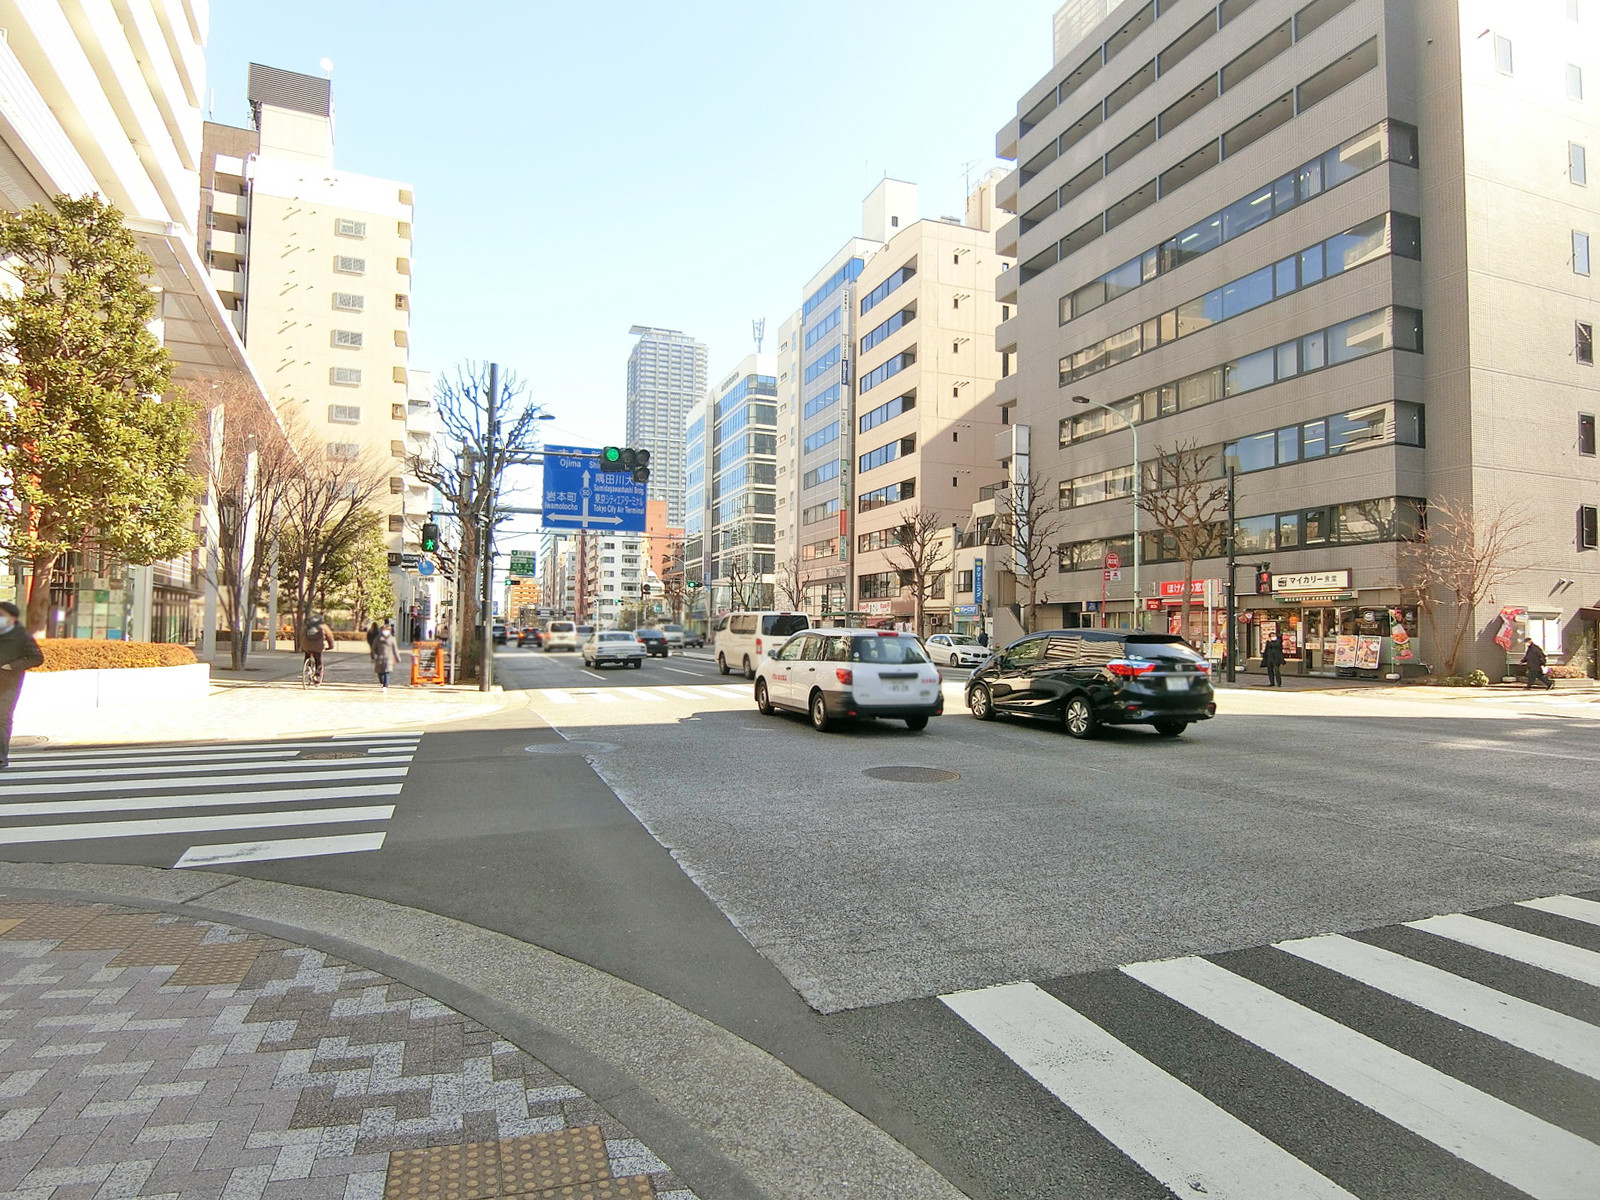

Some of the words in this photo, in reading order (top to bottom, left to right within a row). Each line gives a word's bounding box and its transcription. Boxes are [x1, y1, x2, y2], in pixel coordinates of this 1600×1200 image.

[560, 458, 581, 468] Ojima
[595, 474, 644, 487] 隅田川大
[546, 491, 577, 502] 岩本町
[594, 494, 643, 506] 東京シティエアターミナル
[594, 504, 607, 513] Tokyo
[607, 505, 616, 514] City
[625, 506, 644, 514] Terminal
[1289, 575, 1338, 584] マイカリー食堂
[1166, 582, 1204, 593] ほけん窓
